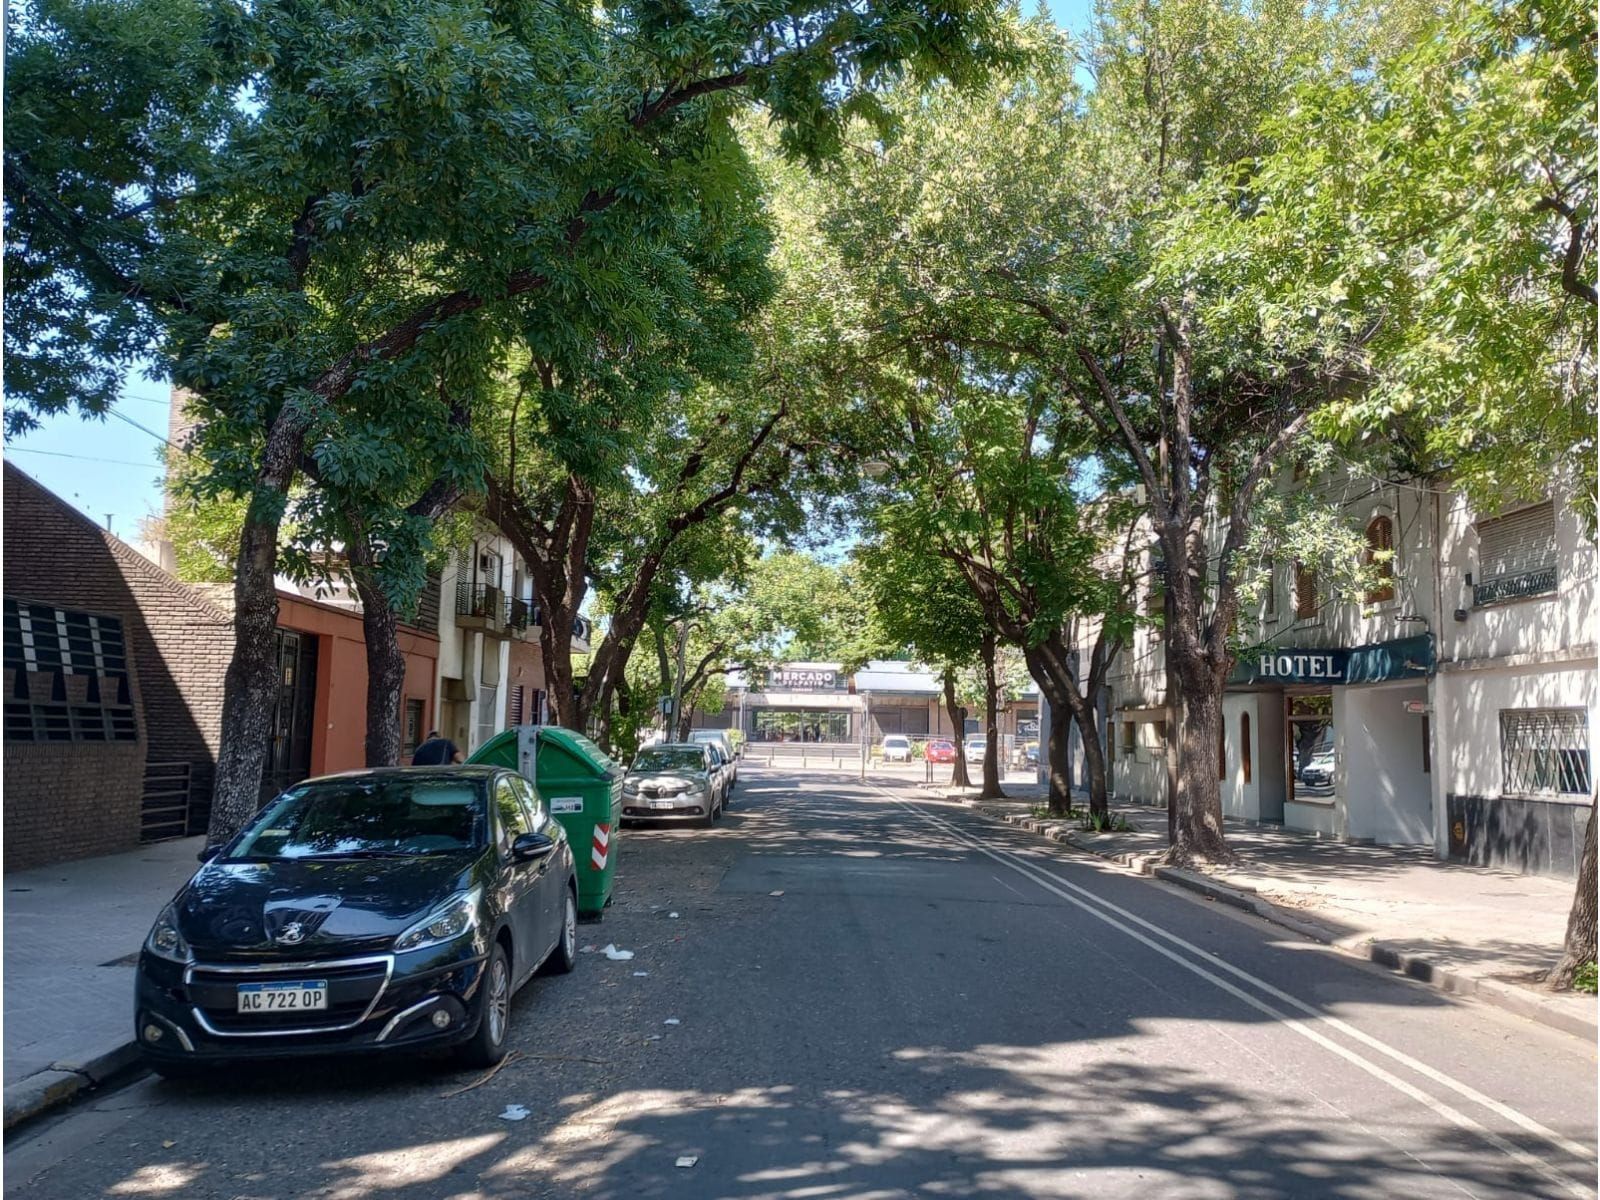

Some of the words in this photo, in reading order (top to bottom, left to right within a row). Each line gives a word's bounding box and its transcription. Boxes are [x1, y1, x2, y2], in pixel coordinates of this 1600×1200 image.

[1260, 654, 1342, 678] HOTEL
[773, 672, 832, 681] MERCADO
[242, 994, 262, 1010] AC
[267, 992, 297, 1009] 722
[302, 991, 322, 1008] OP
